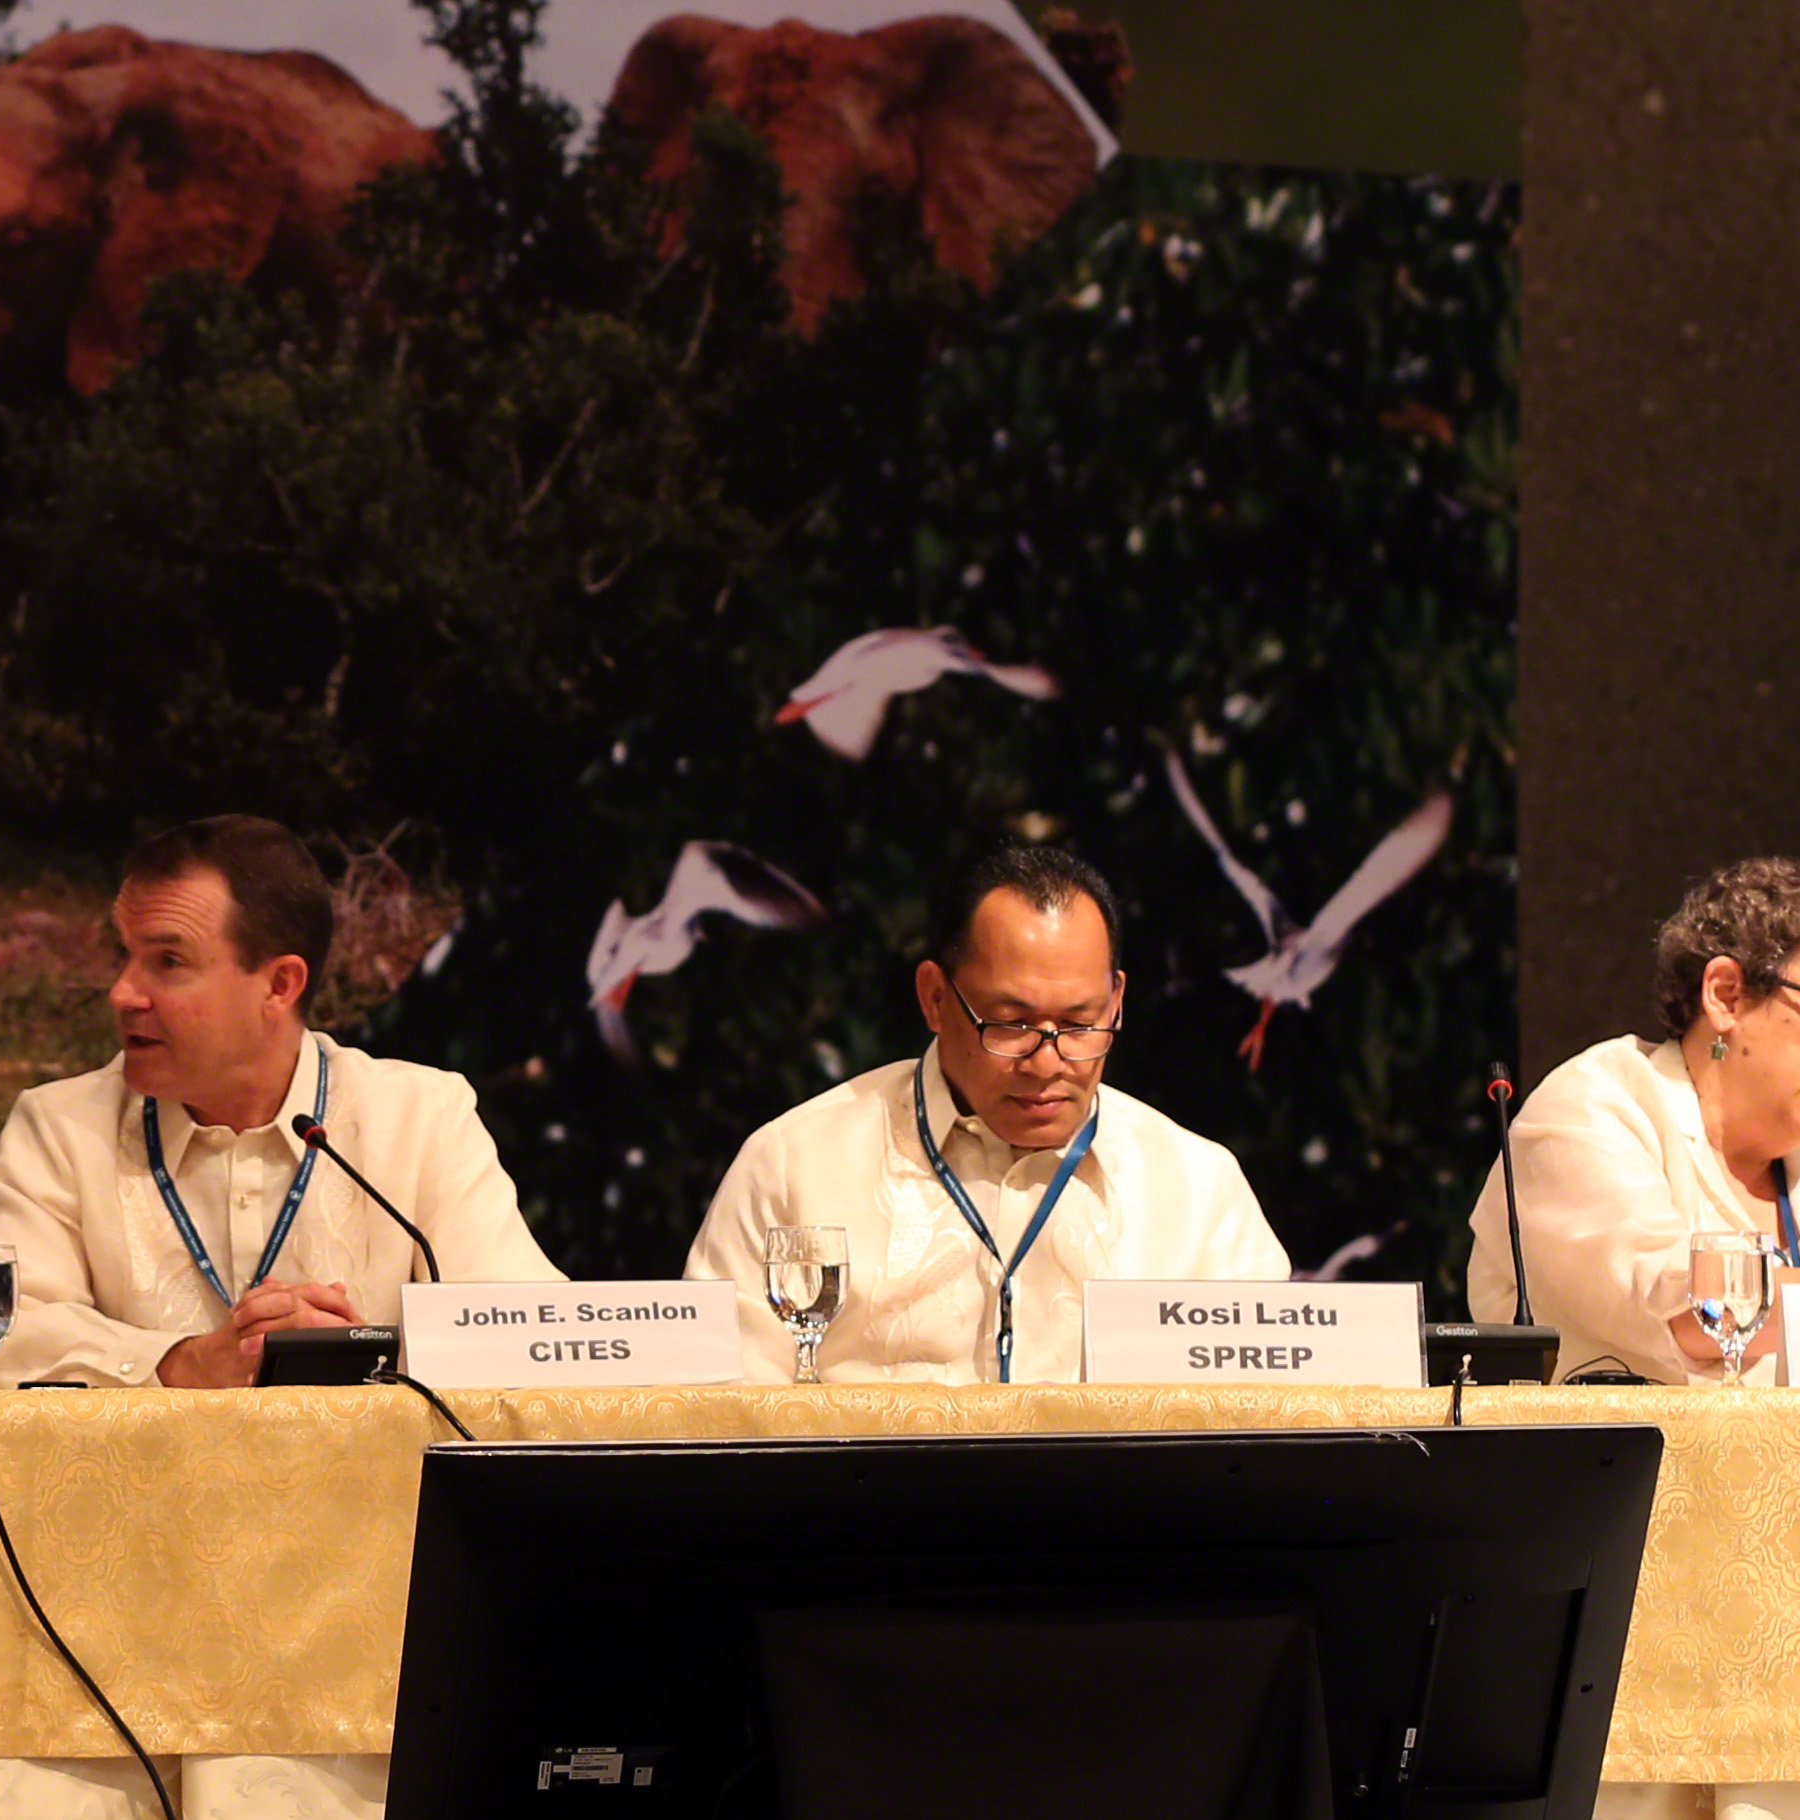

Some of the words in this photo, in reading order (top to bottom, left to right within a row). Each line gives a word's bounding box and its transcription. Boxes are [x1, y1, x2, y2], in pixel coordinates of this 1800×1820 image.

[454, 1307, 528, 1328] John
[538, 1305, 566, 1324] E.
[577, 1302, 697, 1323] Scanlon
[1158, 1302, 1241, 1326] Kosi
[1256, 1303, 1338, 1327] Latu
[529, 1339, 632, 1363] CITES
[1188, 1345, 1313, 1370] SPREP
